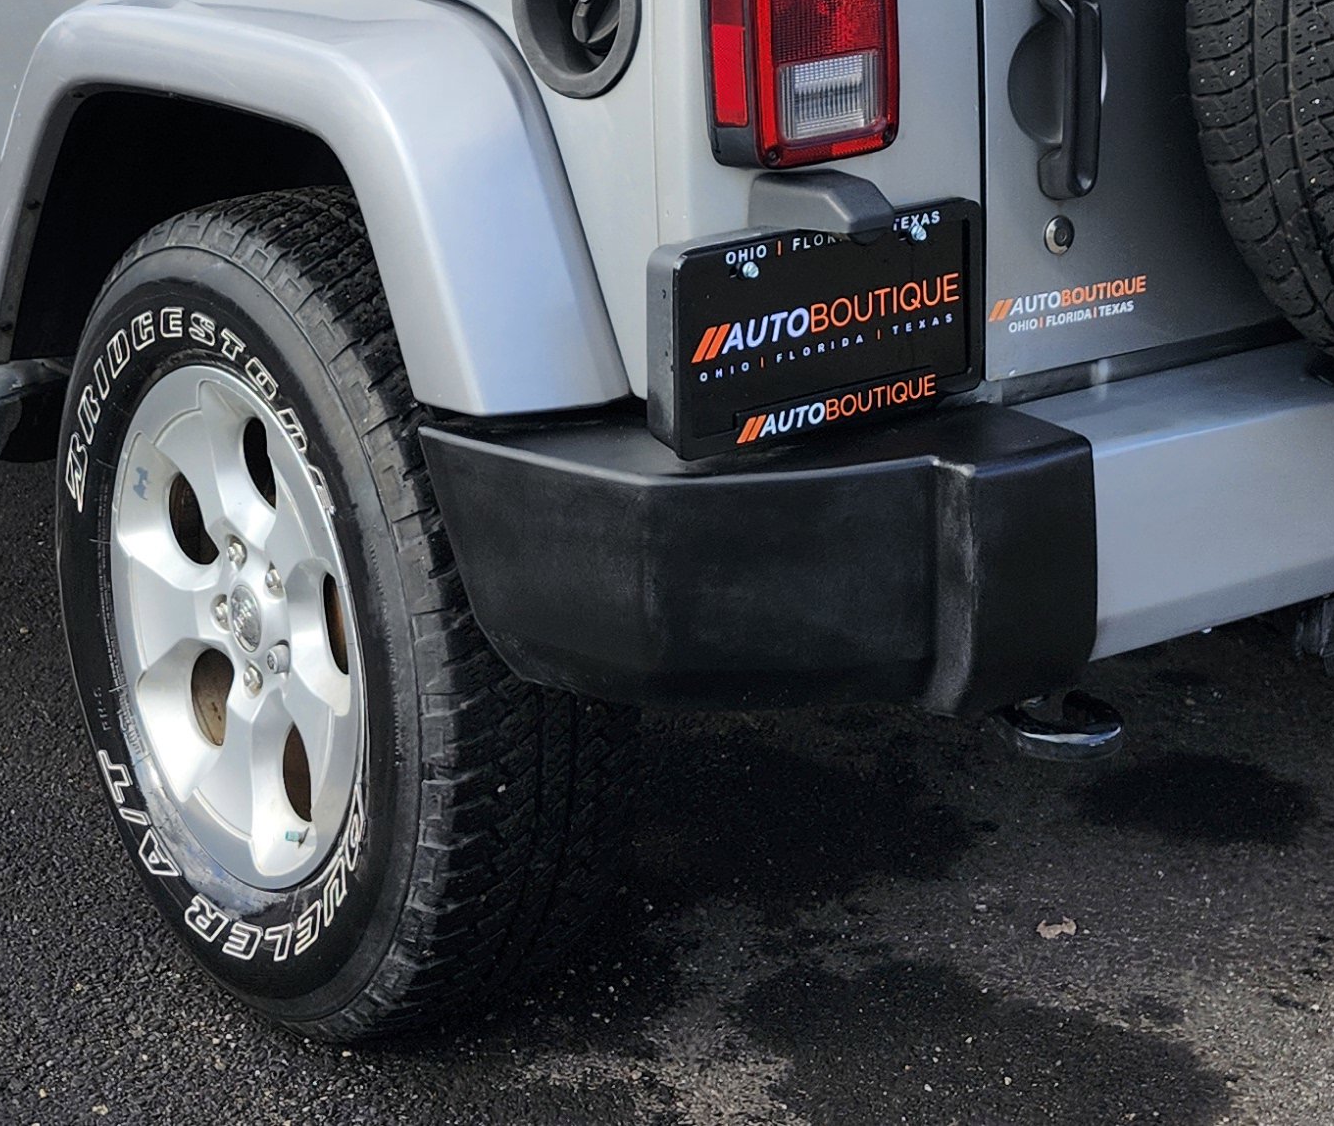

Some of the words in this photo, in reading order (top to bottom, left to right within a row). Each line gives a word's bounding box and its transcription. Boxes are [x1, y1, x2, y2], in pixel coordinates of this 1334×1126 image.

[725, 244, 767, 265] OHIO
[791, 233, 845, 252] FLOR
[1008, 317, 1039, 334] OHIO
[1045, 308, 1092, 327] FLORIDA
[1099, 300, 1135, 318] TEXAS
[699, 361, 750, 383] OHIO
[776, 333, 864, 363] FLORIDA
[892, 312, 954, 335] TEXAS
[98, 749, 183, 877] A/T
